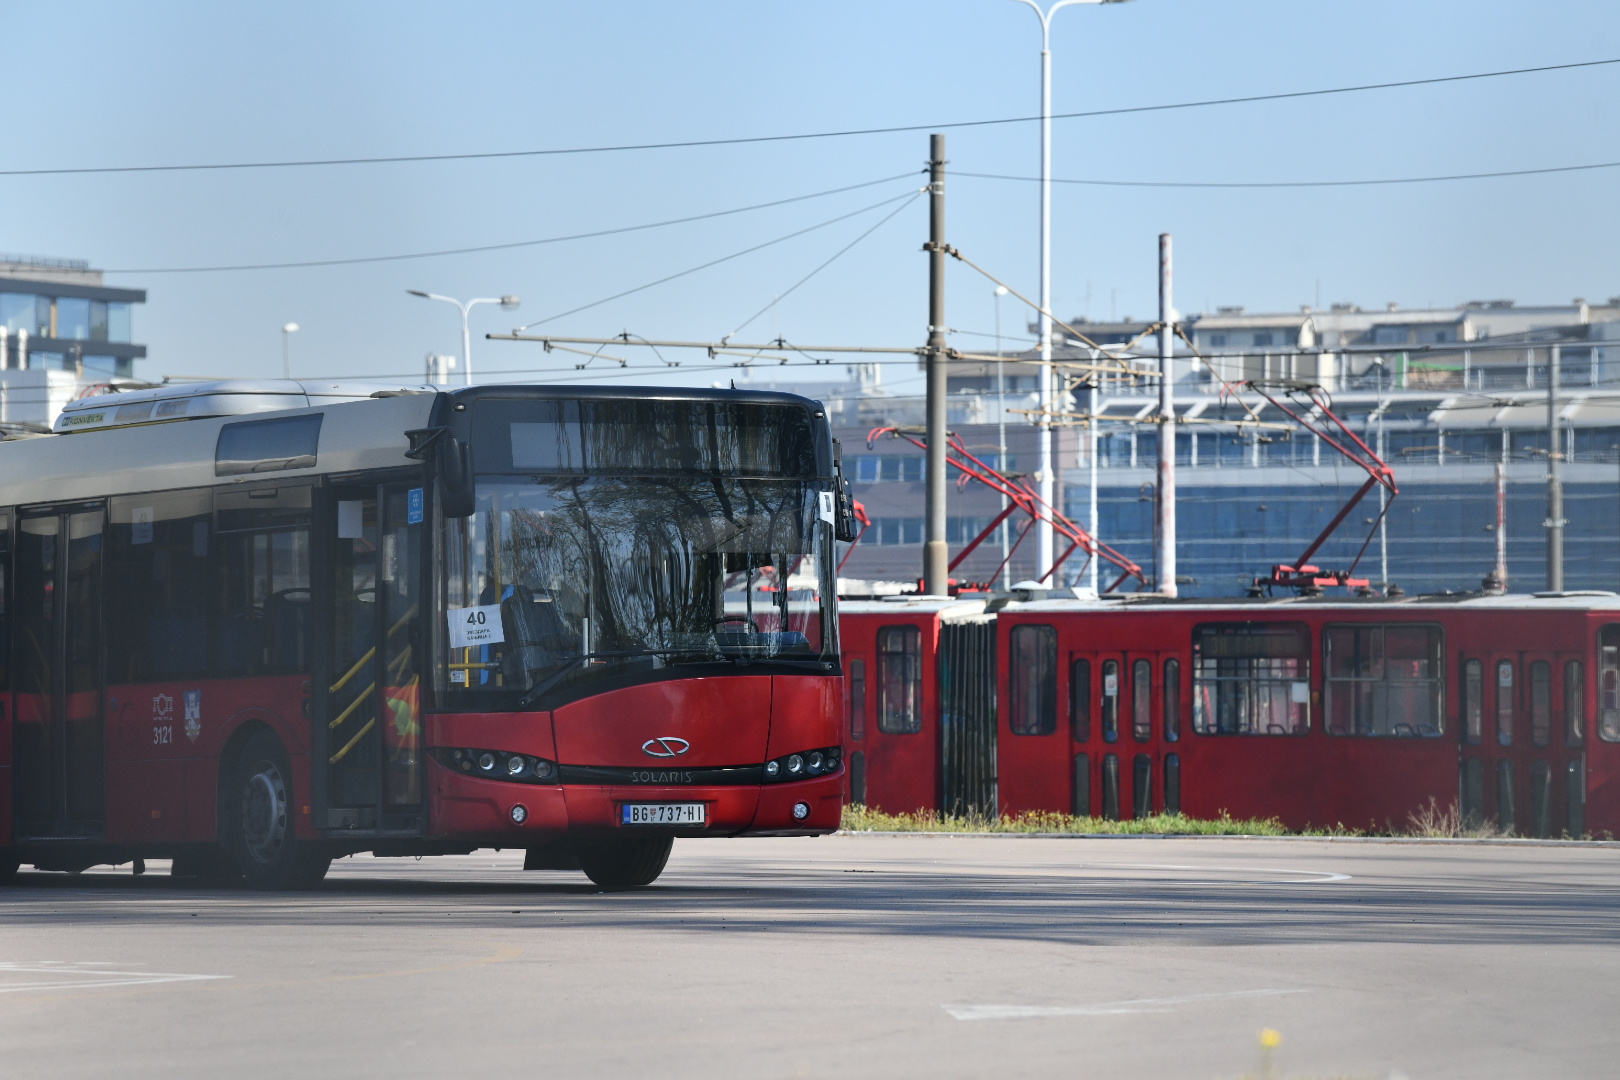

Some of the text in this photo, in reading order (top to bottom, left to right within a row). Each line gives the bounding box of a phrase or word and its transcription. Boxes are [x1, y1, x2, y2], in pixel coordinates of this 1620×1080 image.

[70, 414, 104, 425] KONVEKTA
[467, 611, 486, 625] 40
[153, 725, 172, 745] 3121
[632, 771, 692, 783] SOLARIS
[633, 807, 648, 821] BG
